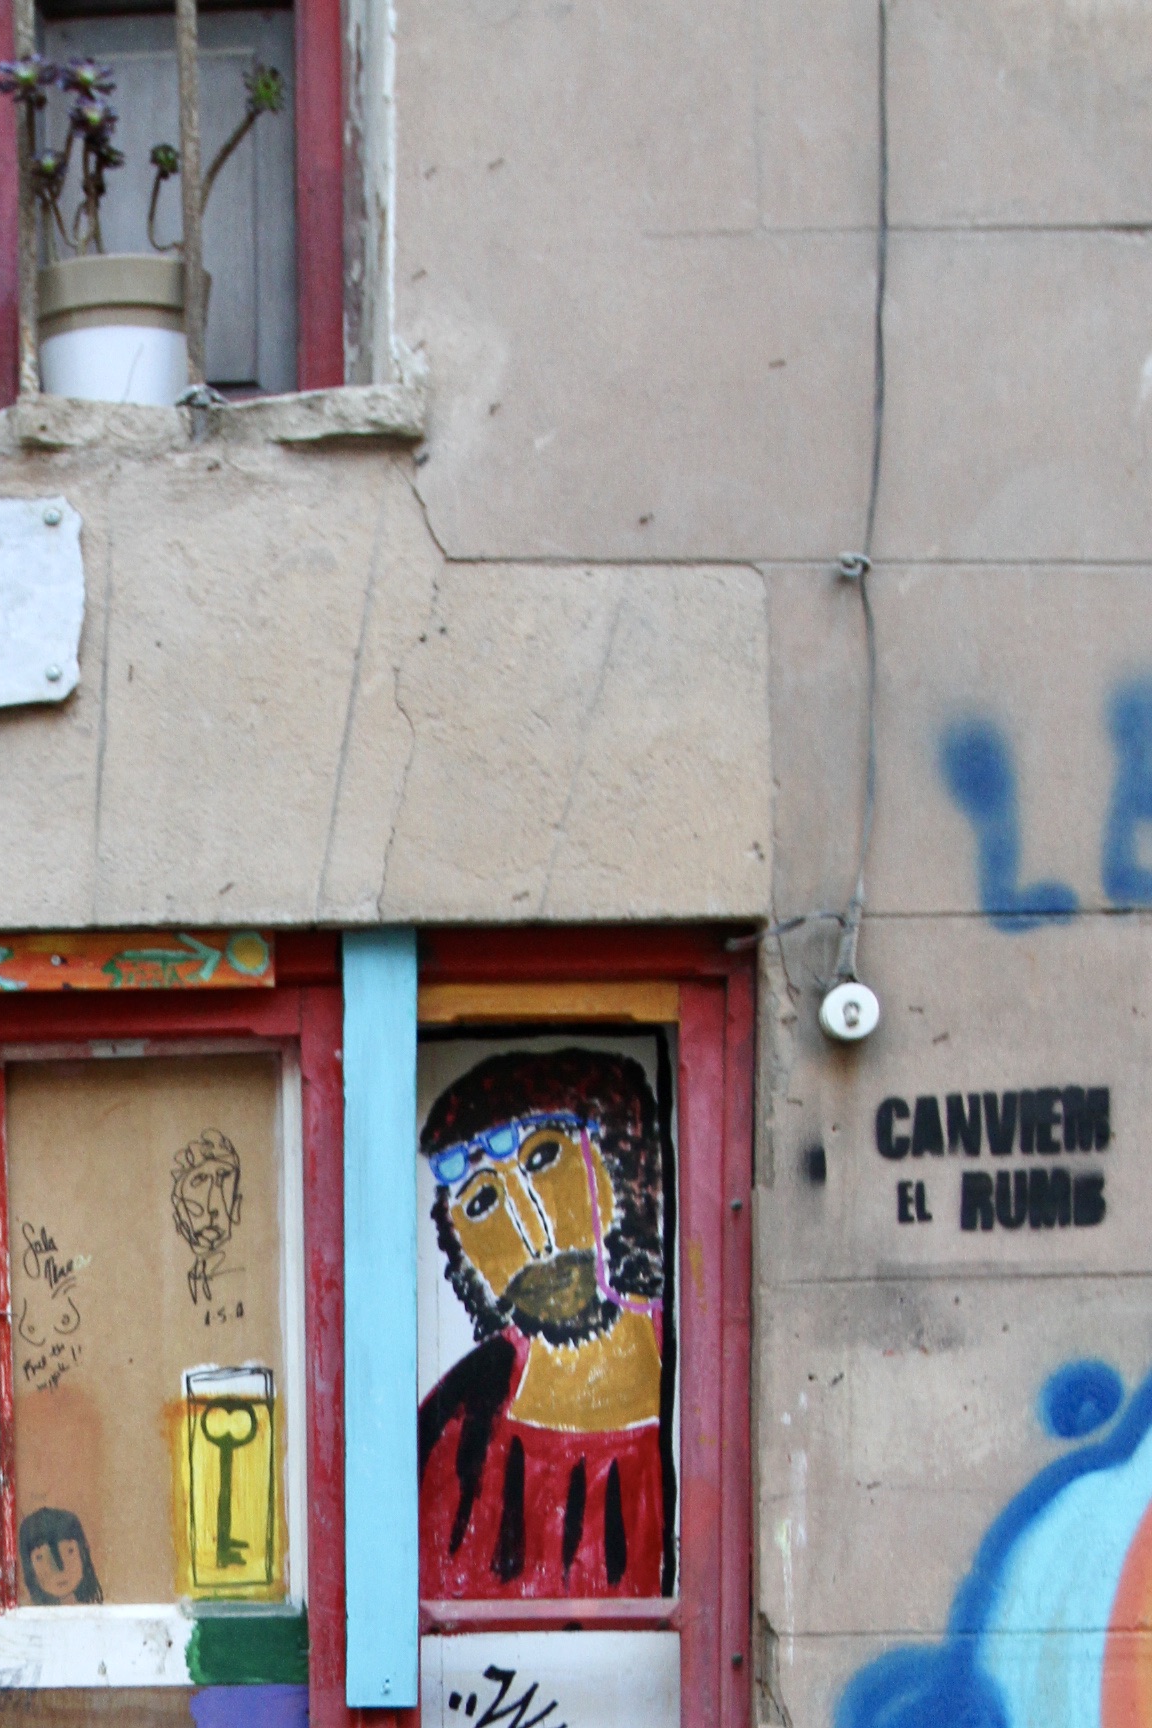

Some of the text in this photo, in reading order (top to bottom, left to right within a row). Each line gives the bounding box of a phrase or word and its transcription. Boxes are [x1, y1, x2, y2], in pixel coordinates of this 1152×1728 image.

[876, 1085, 1111, 1160] CANVIEM
[897, 1168, 1106, 1231] EL RUMB
